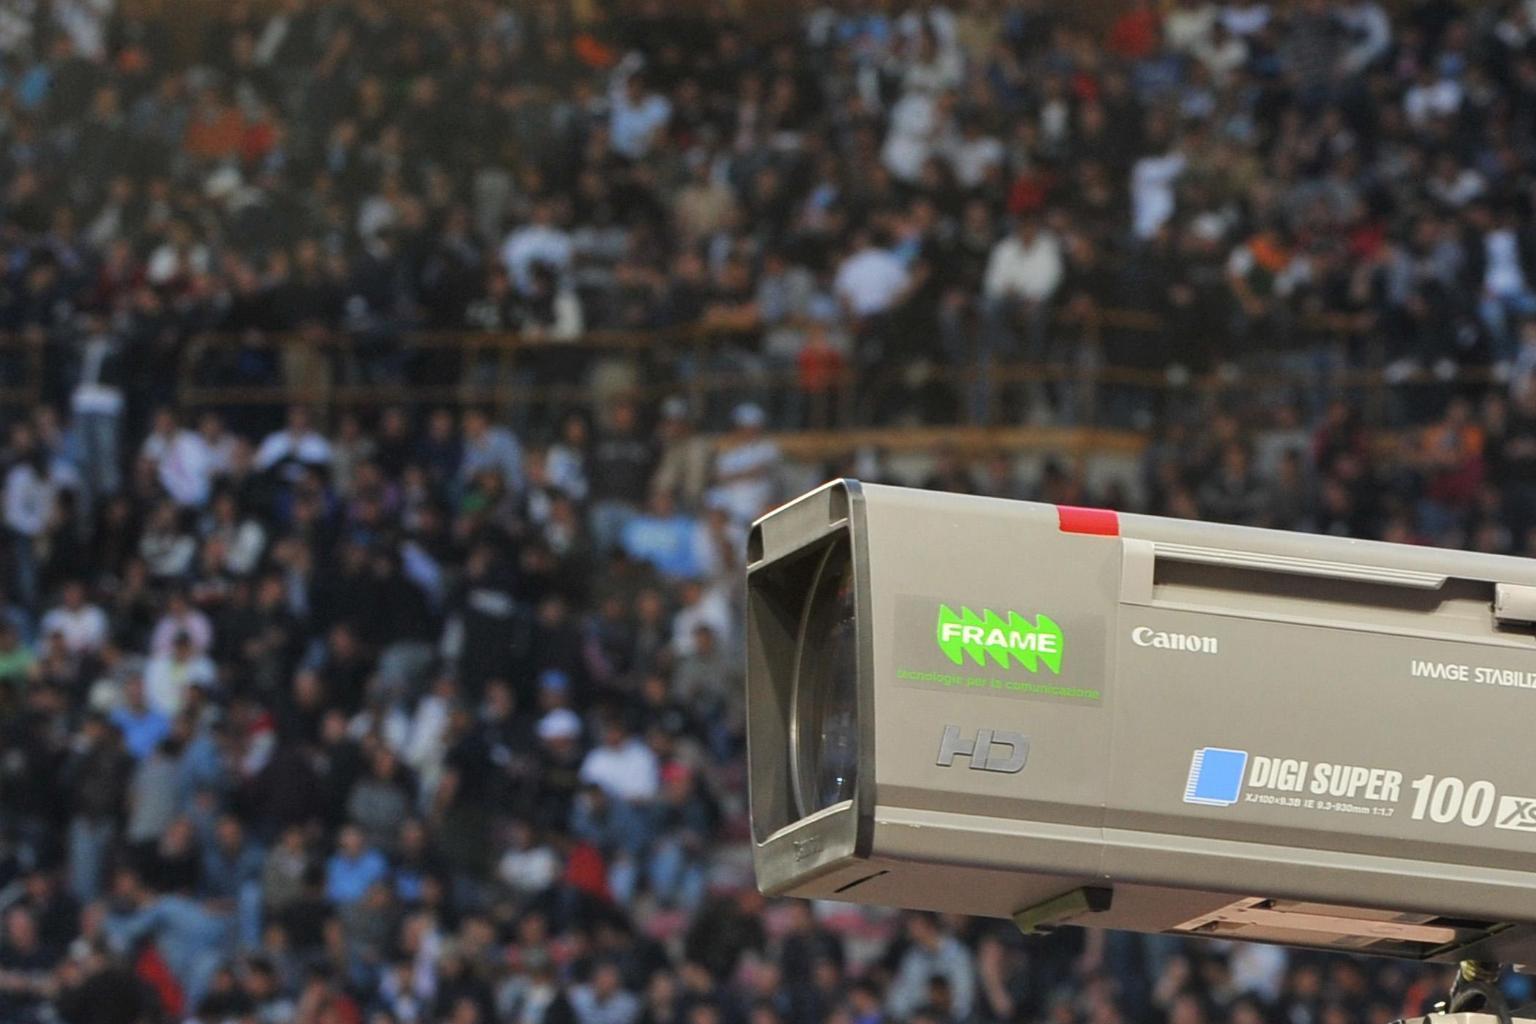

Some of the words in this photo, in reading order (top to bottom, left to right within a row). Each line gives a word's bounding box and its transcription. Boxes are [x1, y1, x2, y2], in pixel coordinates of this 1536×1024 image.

[941, 623, 1057, 653] FRAME
[1132, 627, 1218, 654] Canon
[1411, 660, 1469, 682] IMAGE
[936, 724, 1030, 774] HD
[1248, 756, 1309, 792] DIGI
[1310, 763, 1403, 802] SUPER
[1411, 774, 1496, 827] 100
